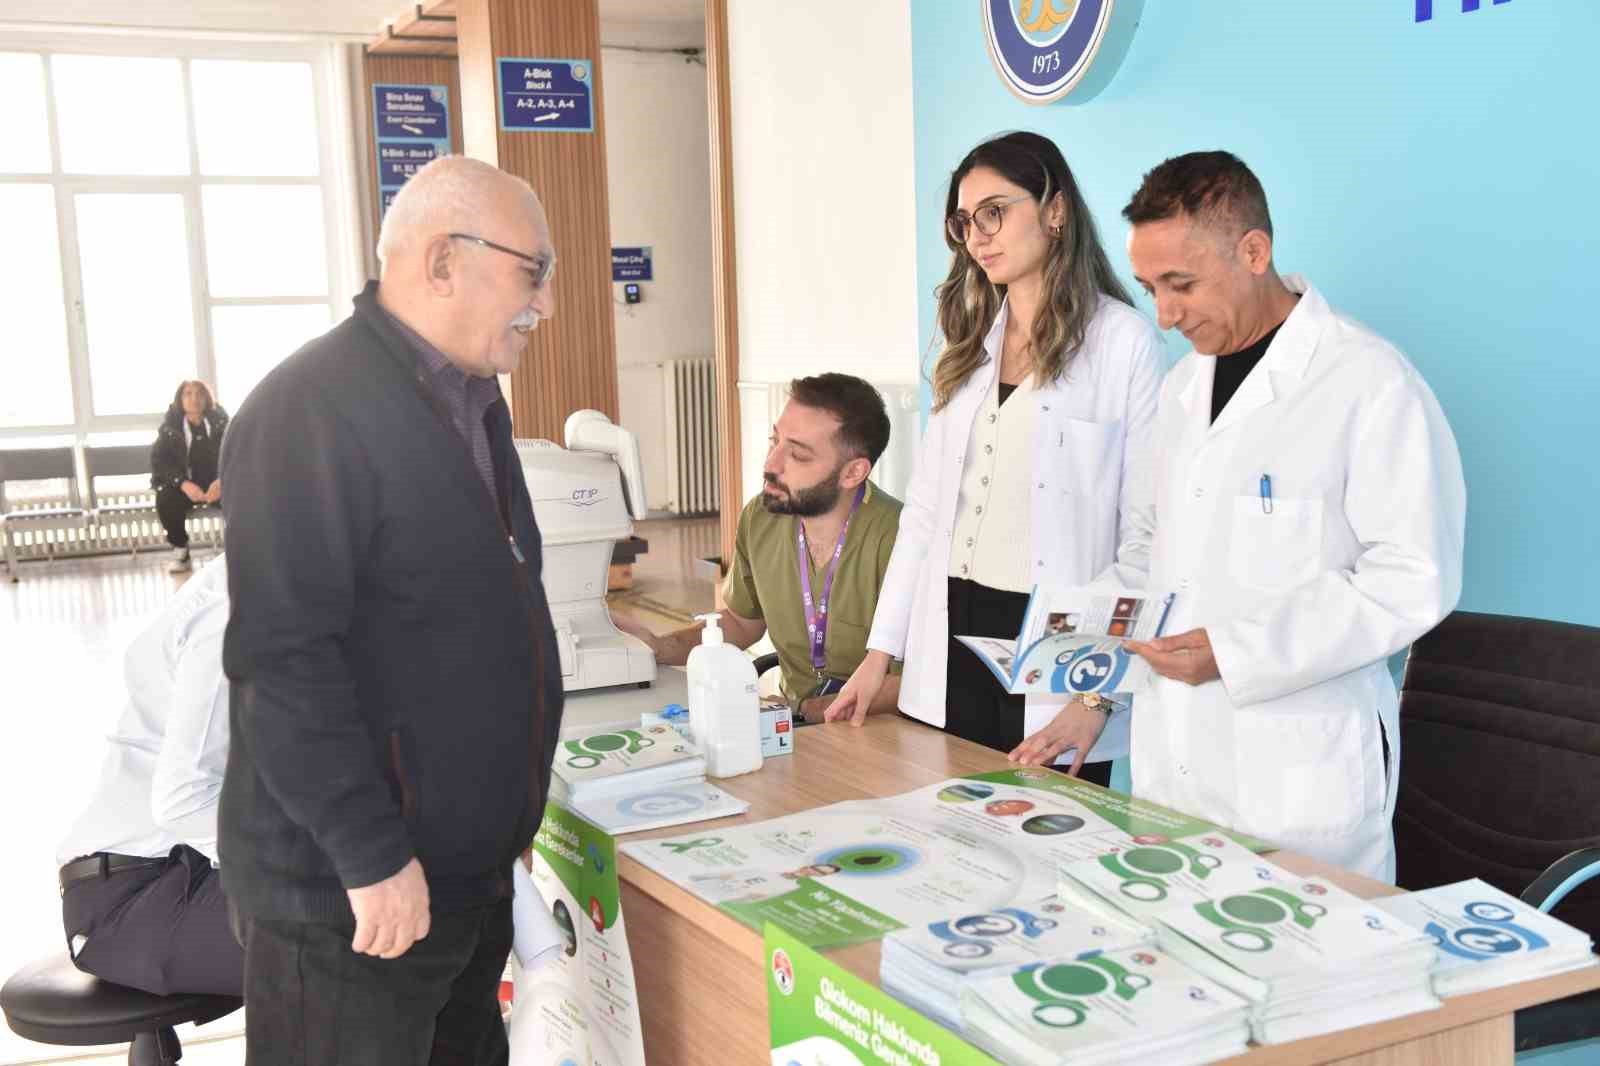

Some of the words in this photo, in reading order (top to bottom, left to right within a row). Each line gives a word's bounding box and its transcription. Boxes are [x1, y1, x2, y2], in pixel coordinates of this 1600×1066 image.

[1032, 50, 1060, 74] 1973
[524, 68, 552, 79] A-Blok
[526, 81, 545, 90] Block
[546, 81, 553, 89] A
[558, 99, 575, 109] A-4
[779, 736, 788, 747] L
